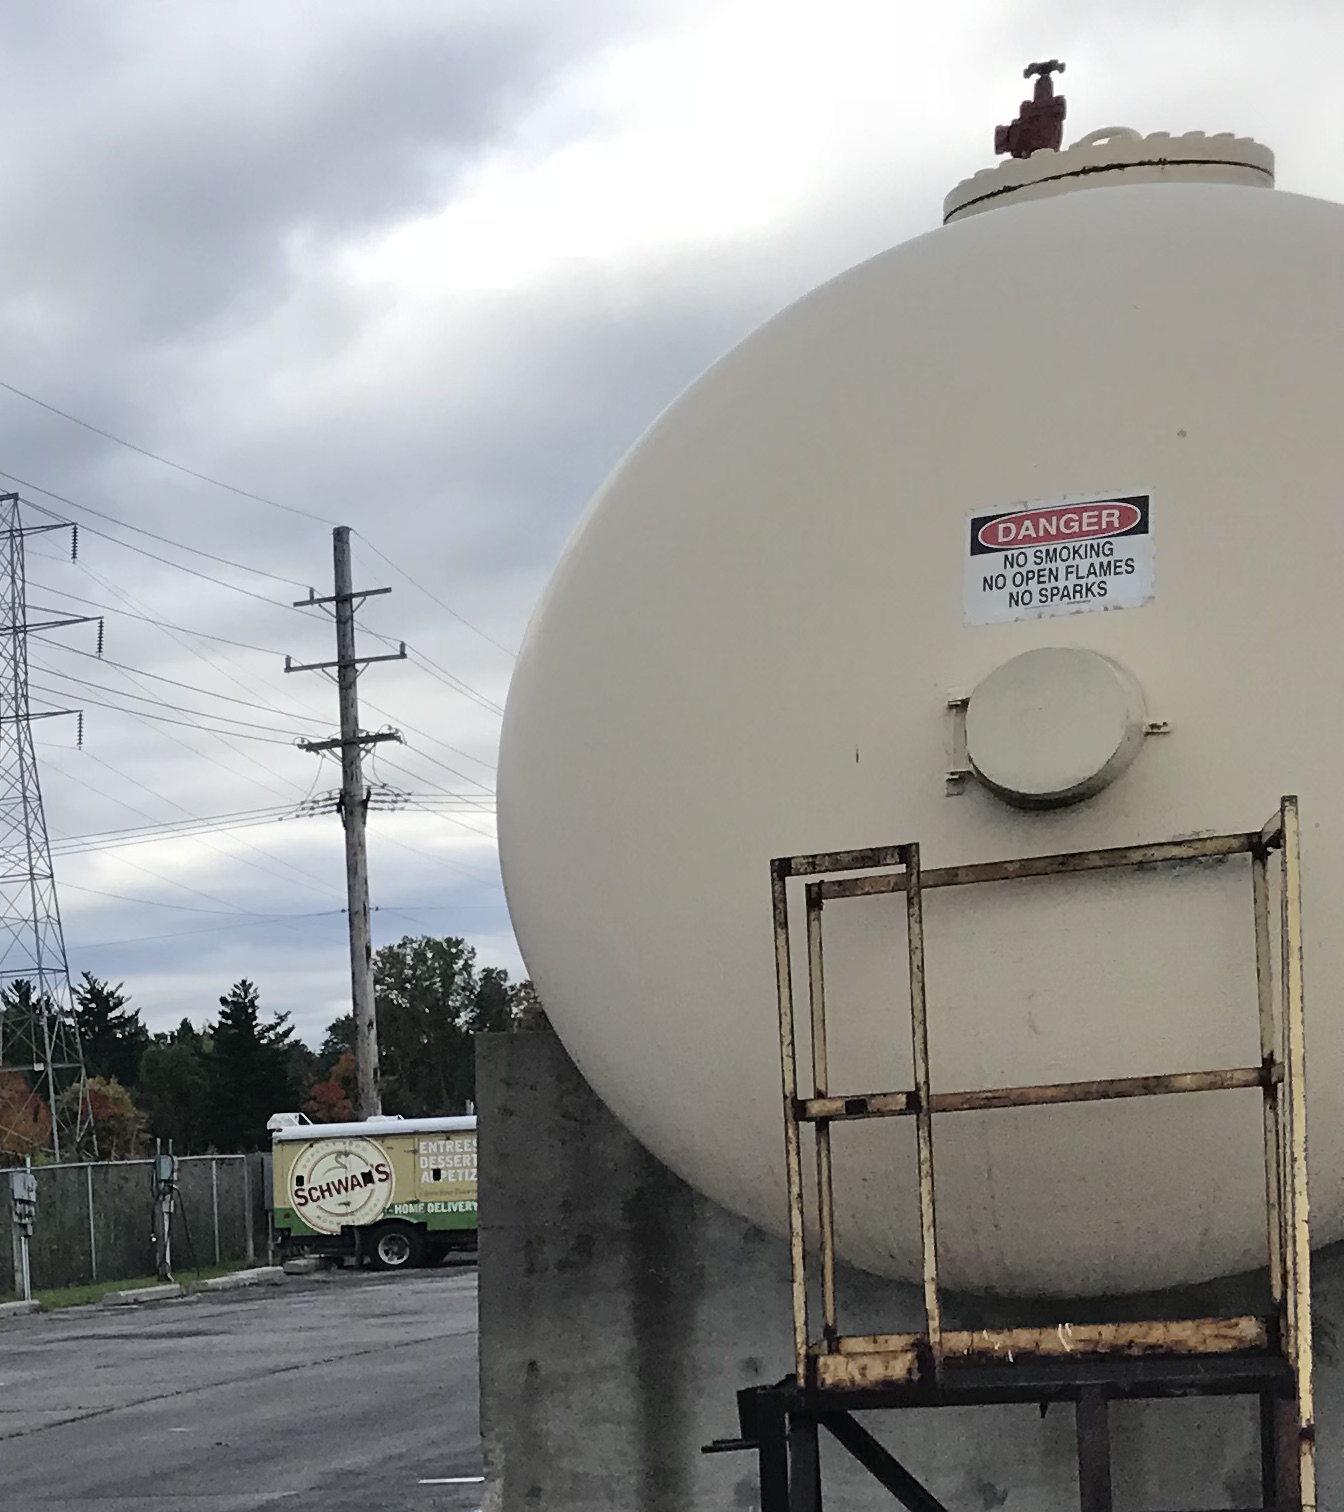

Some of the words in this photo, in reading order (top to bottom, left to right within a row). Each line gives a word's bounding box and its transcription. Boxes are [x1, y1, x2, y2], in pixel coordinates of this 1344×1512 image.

[997, 508, 1121, 543] DANGER
[1003, 551, 1028, 570] NO
[1033, 540, 1114, 566] SMOKING
[982, 573, 1007, 592] NO
[1012, 566, 1059, 588] OPEN
[1064, 557, 1135, 581] FLAMES
[1008, 589, 1033, 608] NO
[1038, 580, 1108, 604] SPARKS
